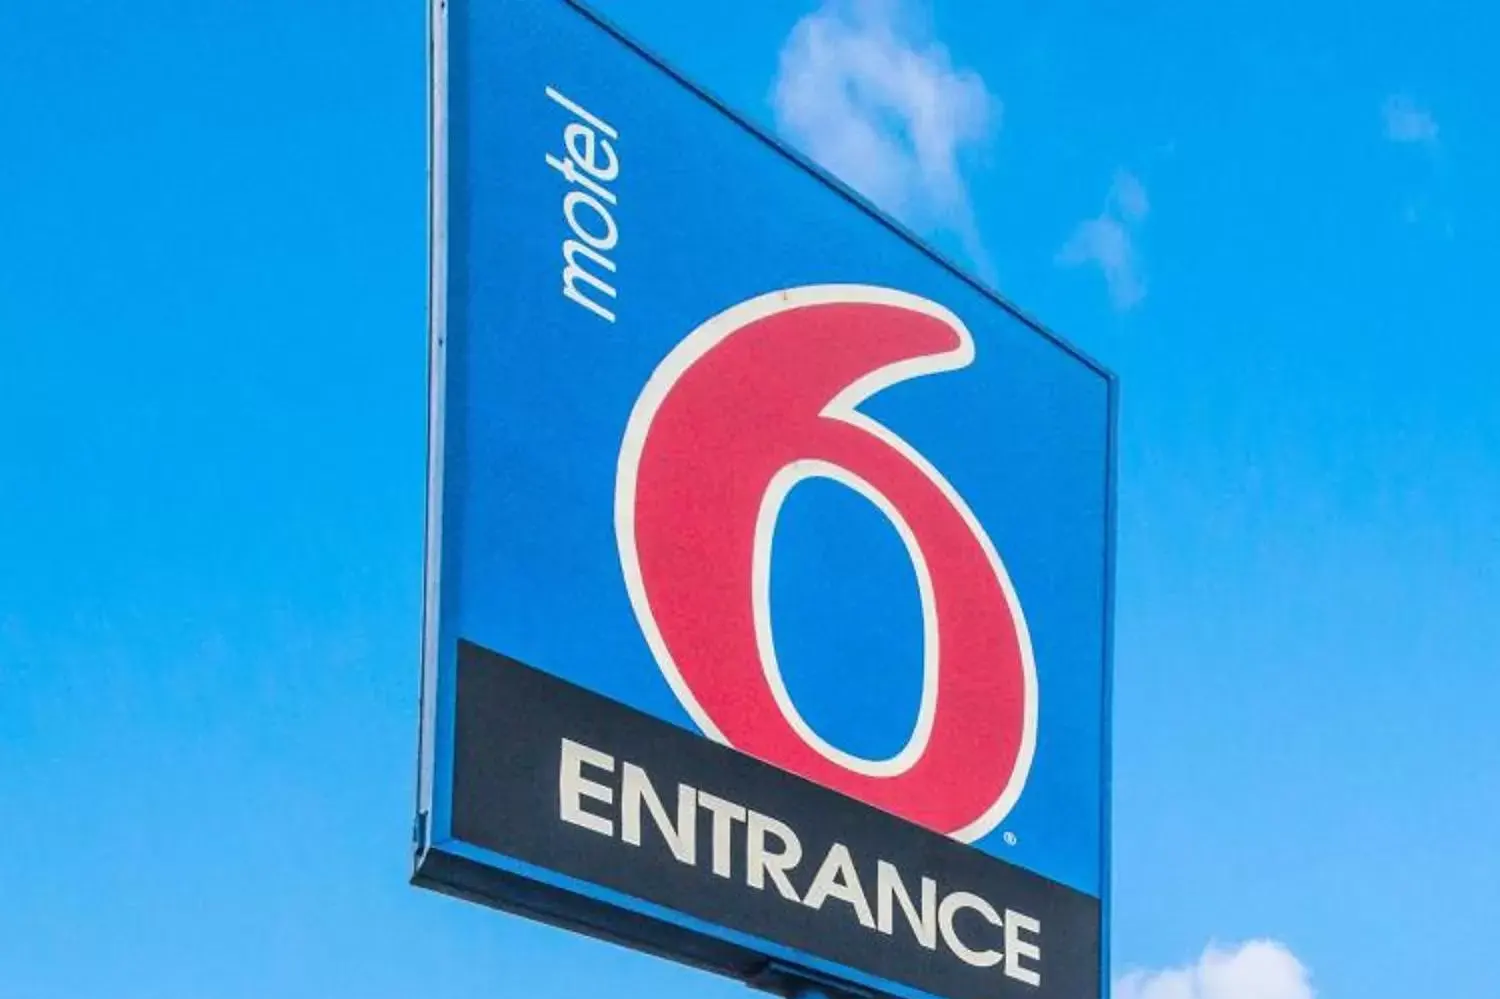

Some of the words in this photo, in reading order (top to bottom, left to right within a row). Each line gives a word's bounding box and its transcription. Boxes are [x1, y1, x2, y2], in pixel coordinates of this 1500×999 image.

[545, 86, 620, 323] motel
[614, 283, 1039, 843] 6
[559, 736, 1042, 987] ENTRANCE
